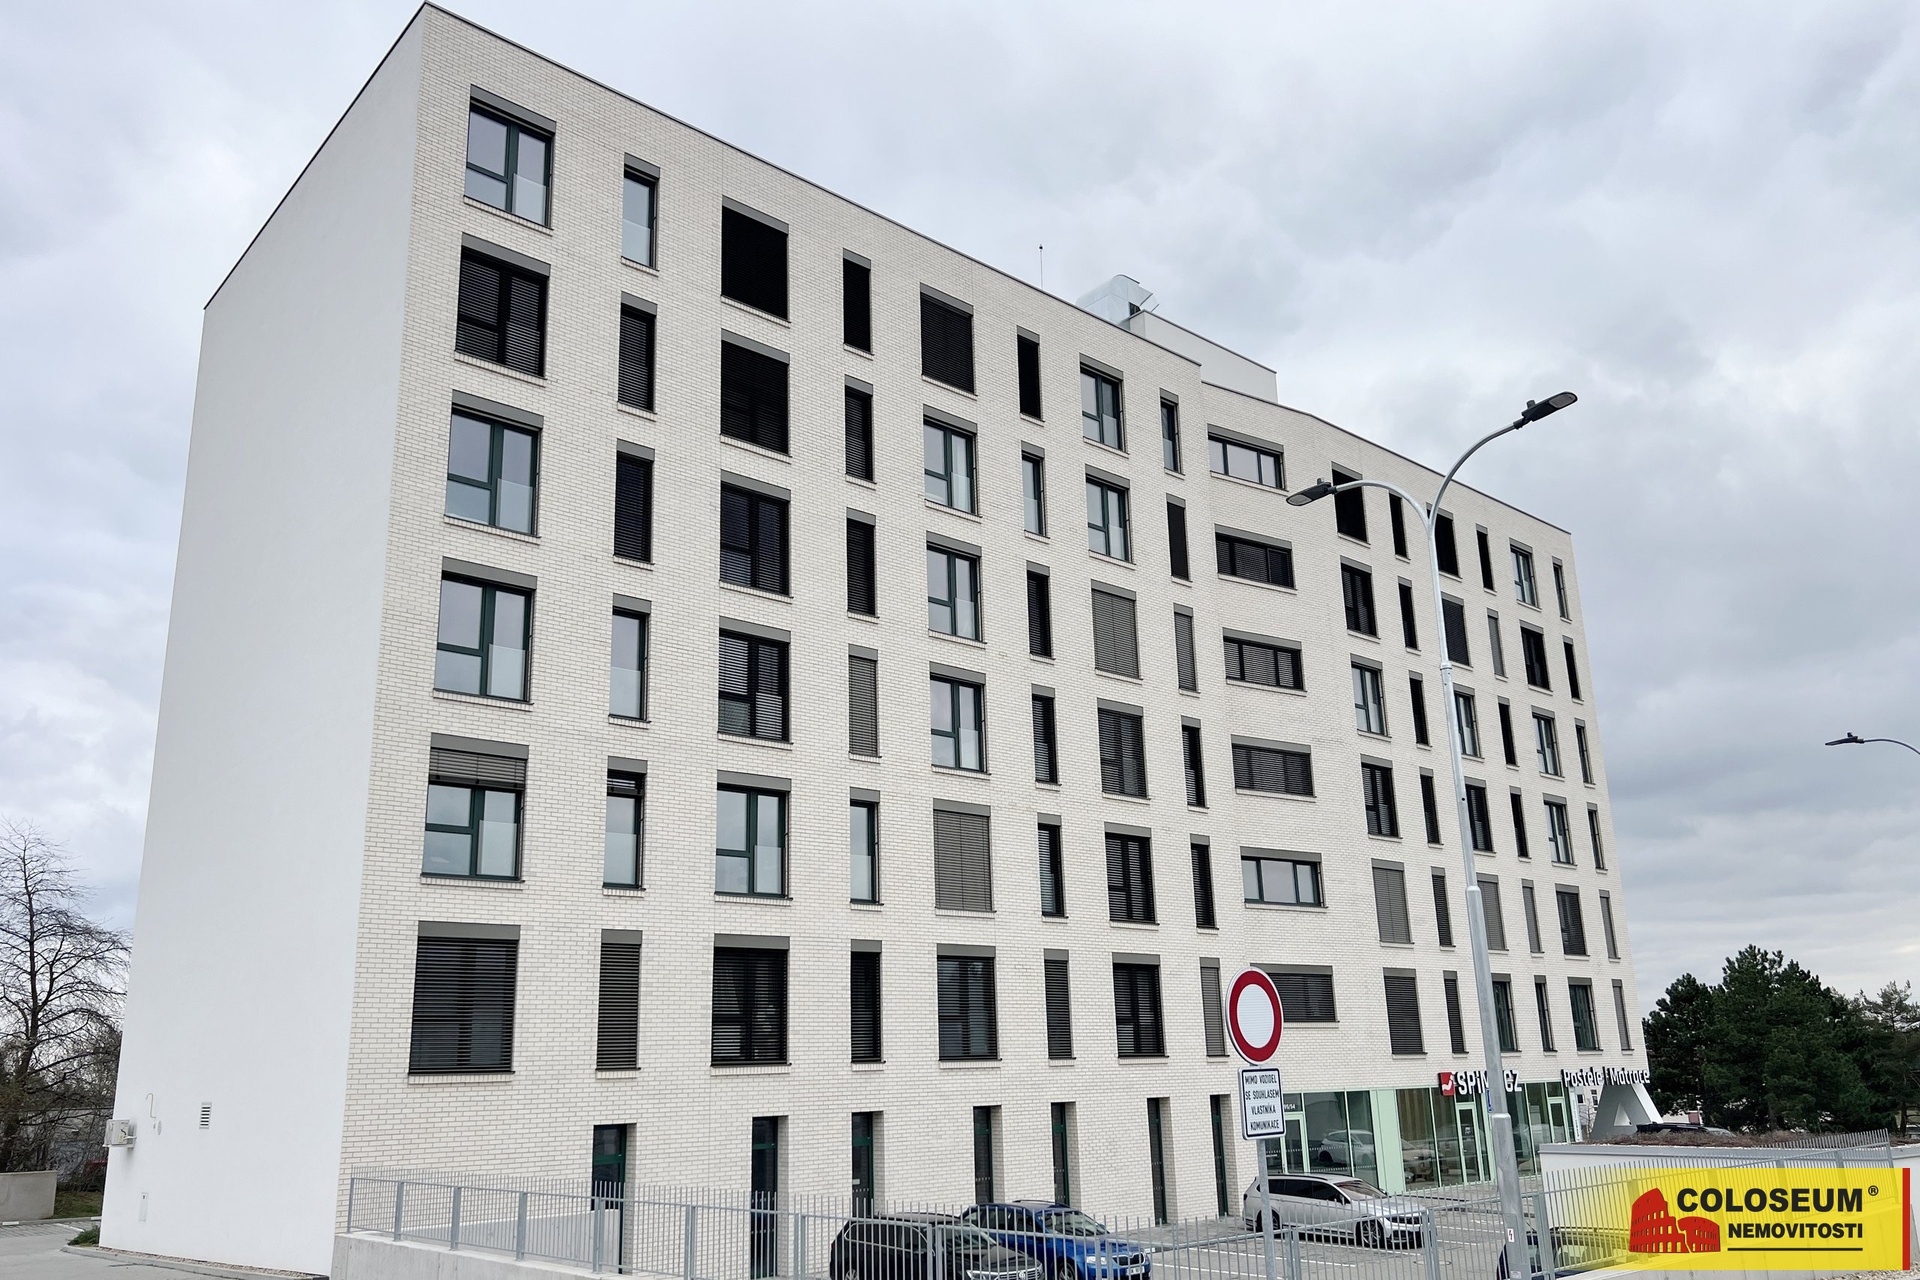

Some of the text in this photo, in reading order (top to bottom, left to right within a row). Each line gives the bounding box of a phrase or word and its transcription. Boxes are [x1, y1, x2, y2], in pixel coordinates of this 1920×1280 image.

[1245, 1074, 1277, 1084] MIMO VOZIDEL
[1562, 1067, 1651, 1087] Postele Matrace
[1245, 1089, 1279, 1100] SE SOUHLASEM
[1250, 1120, 1279, 1131] KOMUNIKACE
